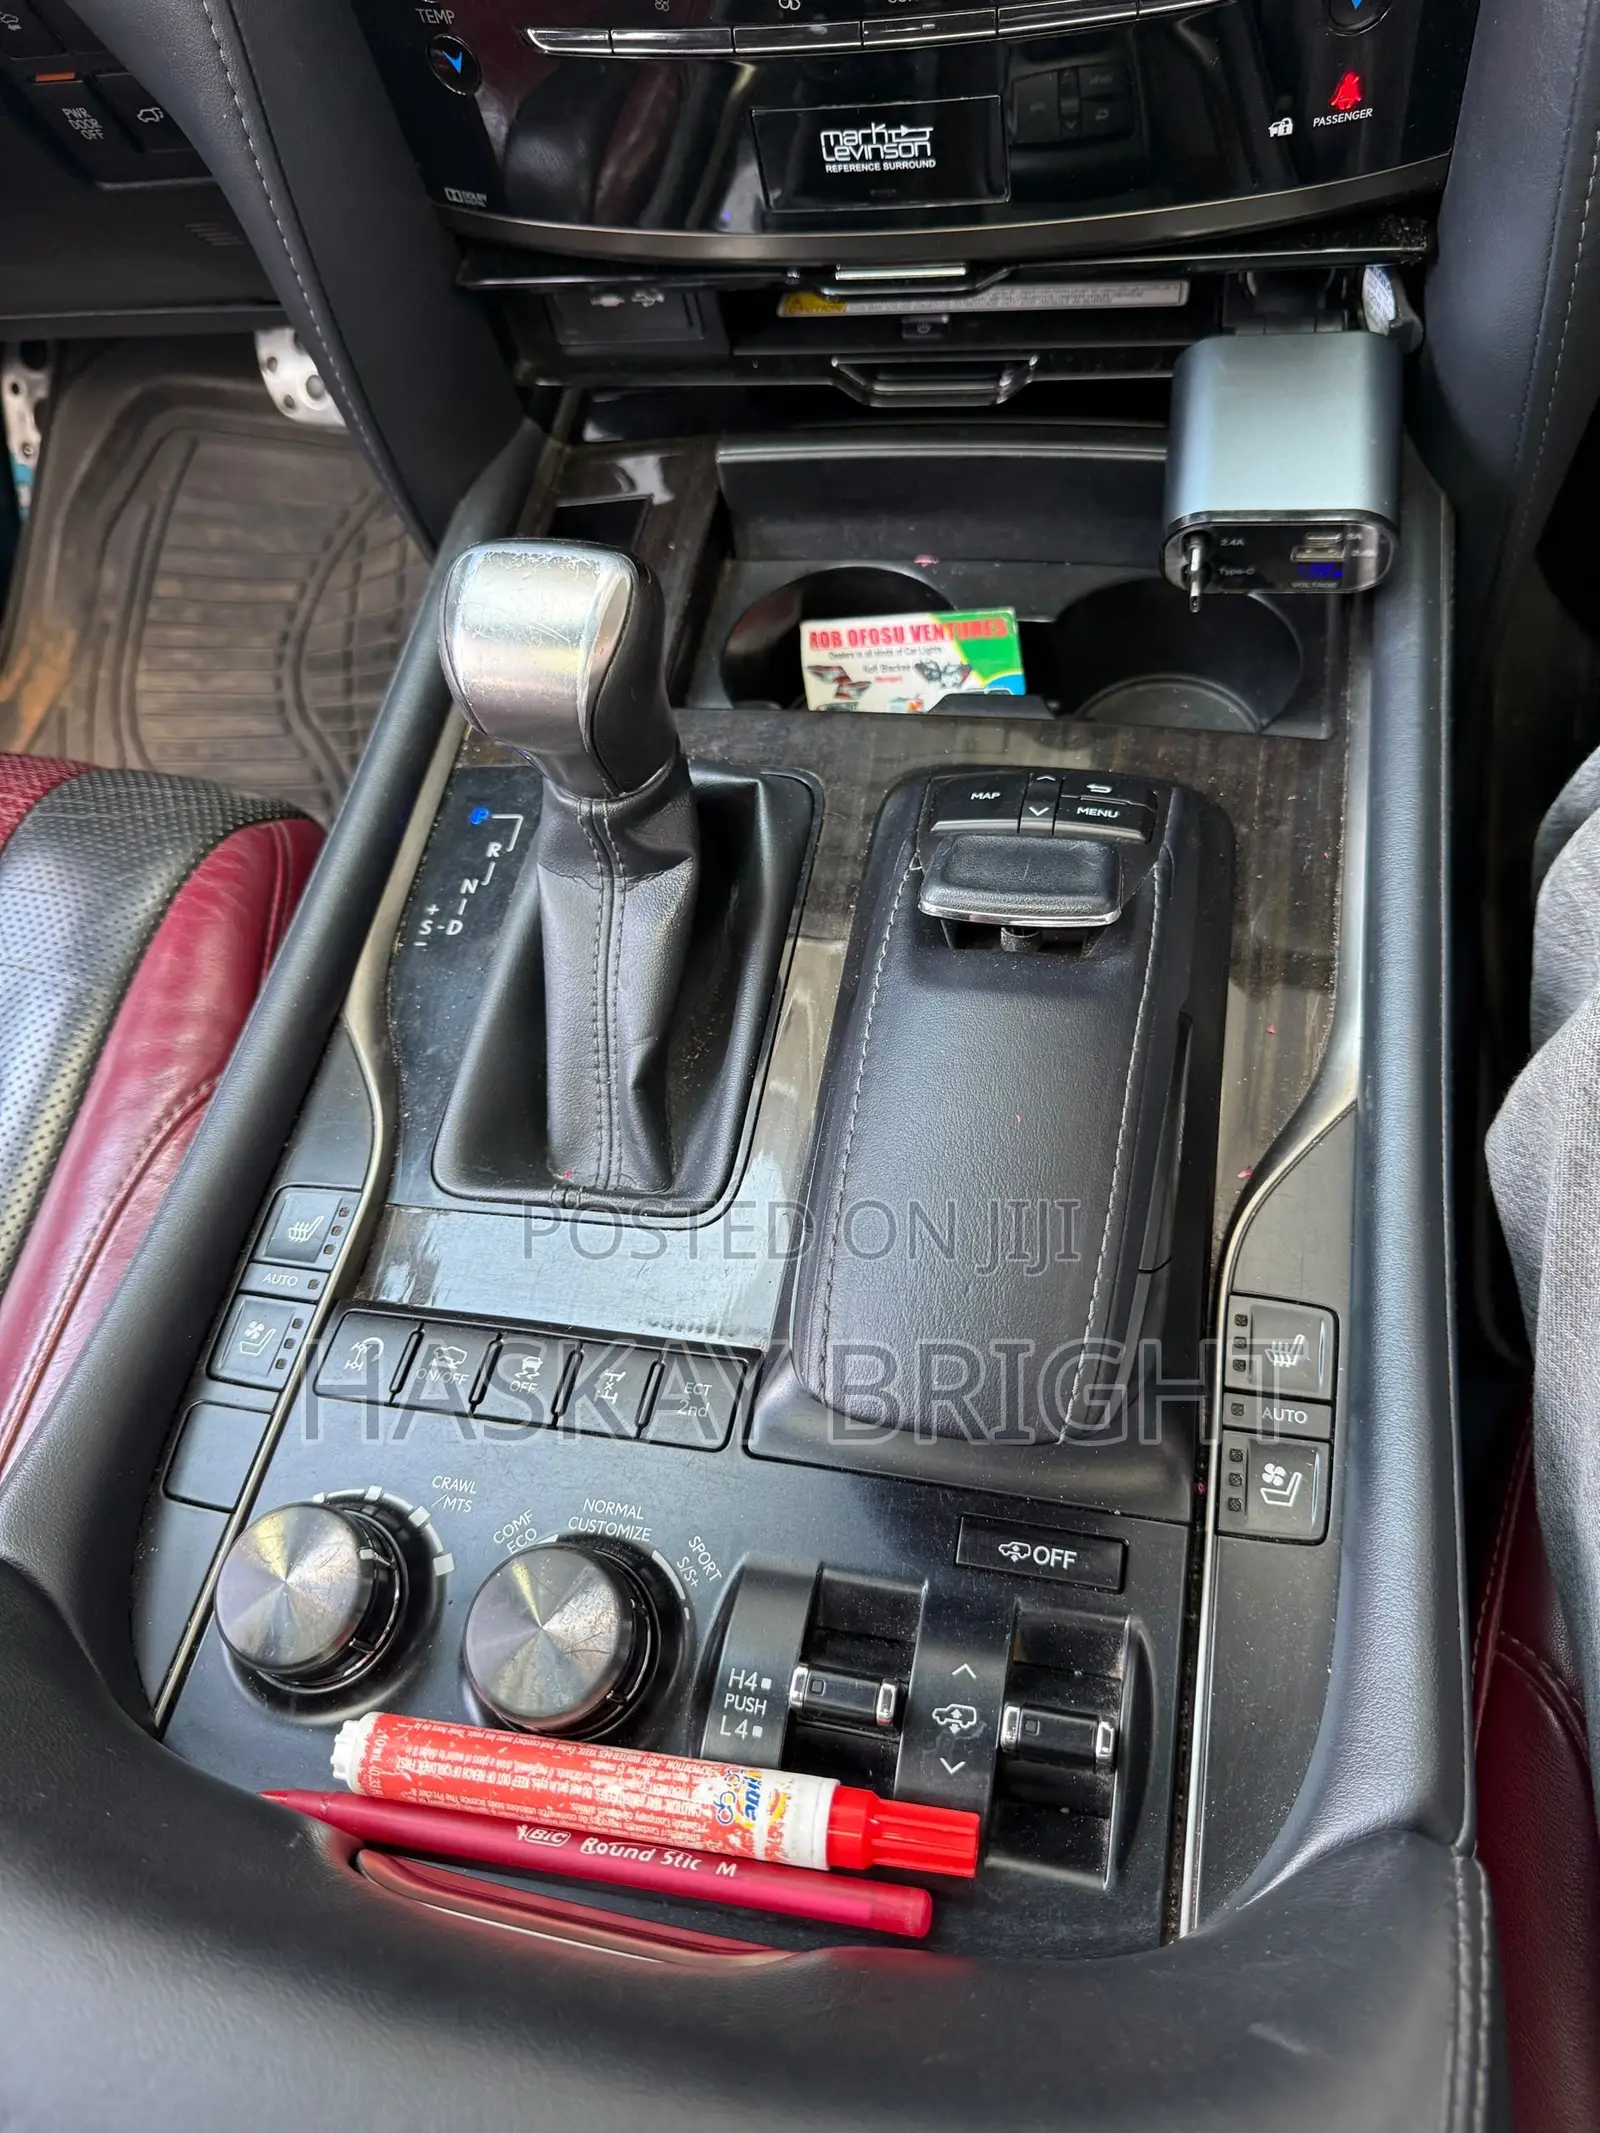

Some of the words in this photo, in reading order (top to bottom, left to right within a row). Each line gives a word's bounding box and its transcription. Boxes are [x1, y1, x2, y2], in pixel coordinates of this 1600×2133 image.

[415, 8, 455, 25] TEMP
[68, 118, 103, 130] DOOR
[1313, 108, 1373, 127] PASSENGER
[80, 129, 104, 140] OFF
[825, 161, 881, 173] REFERENCE
[882, 159, 937, 172] SURROUND
[847, 626, 905, 648] OFOSU
[909, 618, 1008, 642] VENTURES
[971, 791, 1001, 800] MAP
[470, 807, 489, 825] P
[1077, 806, 1119, 818] MENU
[486, 842, 502, 857] R
[460, 879, 479, 894] N
[262, 1273, 299, 1287] AUTO
[416, 1368, 470, 1385] ON/OFF
[509, 1380, 538, 1393] OFF
[684, 1382, 712, 1397] ECT
[677, 1399, 710, 1417] 2nd
[1262, 1406, 1308, 1424] AUTO
[432, 1475, 477, 1495] CRAWL
[431, 1493, 473, 1513] /MTS
[582, 1498, 645, 1521] NORMAL
[493, 1509, 534, 1545] COMF
[568, 1516, 653, 1543] CUSTOMIZE
[506, 1528, 538, 1556] ECO
[688, 1535, 723, 1582] SPORT
[1033, 1545, 1077, 1570] OFF
[676, 1556, 699, 1588] S/S+
[728, 1667, 758, 1692] H4
[724, 1692, 767, 1716] PUSH
[495, 1733, 513, 1742] avec
[512, 1736, 539, 1748] contact
[451, 1765, 462, 1778] OF
[461, 1766, 486, 1782] REACH
[485, 1770, 496, 1783] OF
[496, 1772, 511, 1786] OUT
[511, 1774, 530, 1788] KEEP
[580, 1836, 657, 1863] Round
[660, 1850, 702, 1872] Stic
[715, 1861, 737, 1878] M
